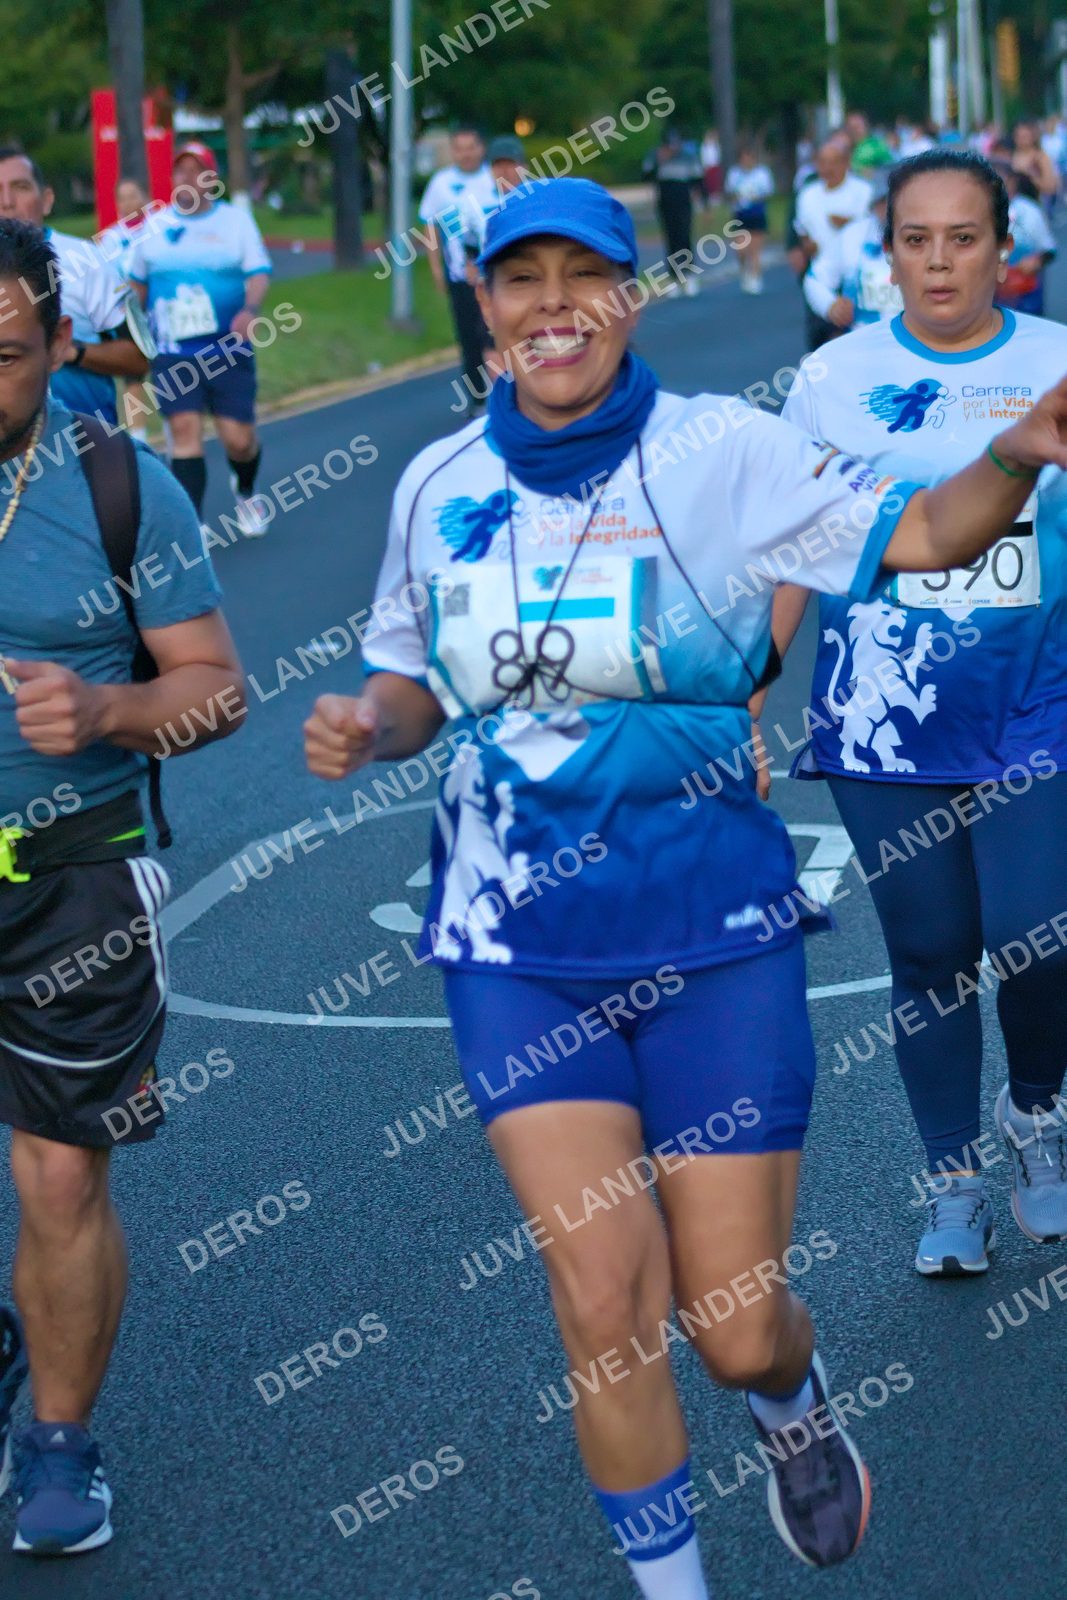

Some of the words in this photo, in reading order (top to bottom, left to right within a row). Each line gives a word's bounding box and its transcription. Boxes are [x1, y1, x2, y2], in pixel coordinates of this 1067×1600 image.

[961, 385, 1032, 398] Carrera
[963, 400, 984, 413] por
[988, 398, 1000, 409] la
[1003, 397, 1034, 409] Vida
[963, 410, 970, 422] y
[974, 409, 985, 419] la
